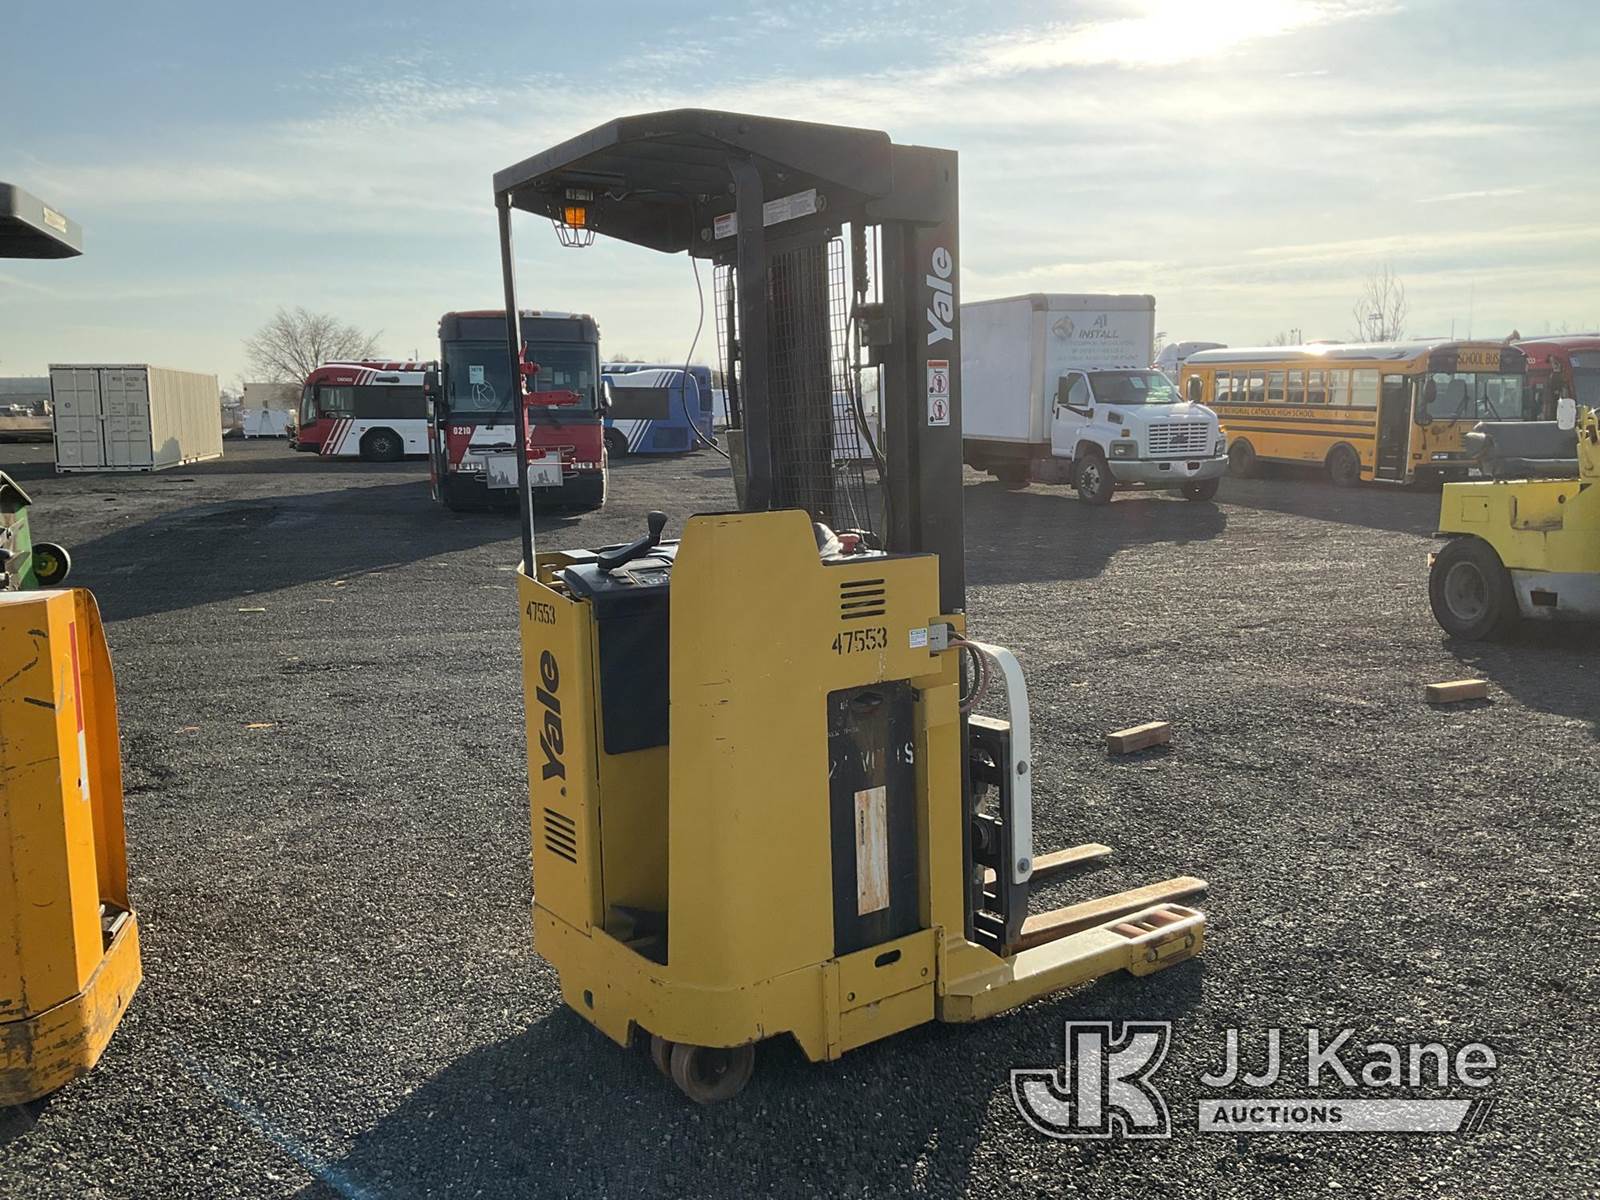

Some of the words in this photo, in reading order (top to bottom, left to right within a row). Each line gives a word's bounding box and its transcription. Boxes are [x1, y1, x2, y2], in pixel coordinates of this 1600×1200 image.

[926, 247, 954, 346] Yale
[1079, 329, 1119, 339] INSTALL
[1457, 352, 1484, 365] SCHOOL
[1485, 352, 1499, 365] BUS
[1251, 407, 1276, 416] CATHOLIC
[1277, 408, 1291, 417] HIGH
[1292, 408, 1315, 418] SCHOOL
[526, 600, 556, 625] 47553
[831, 626, 888, 656] 47553
[535, 650, 566, 781] Yale
